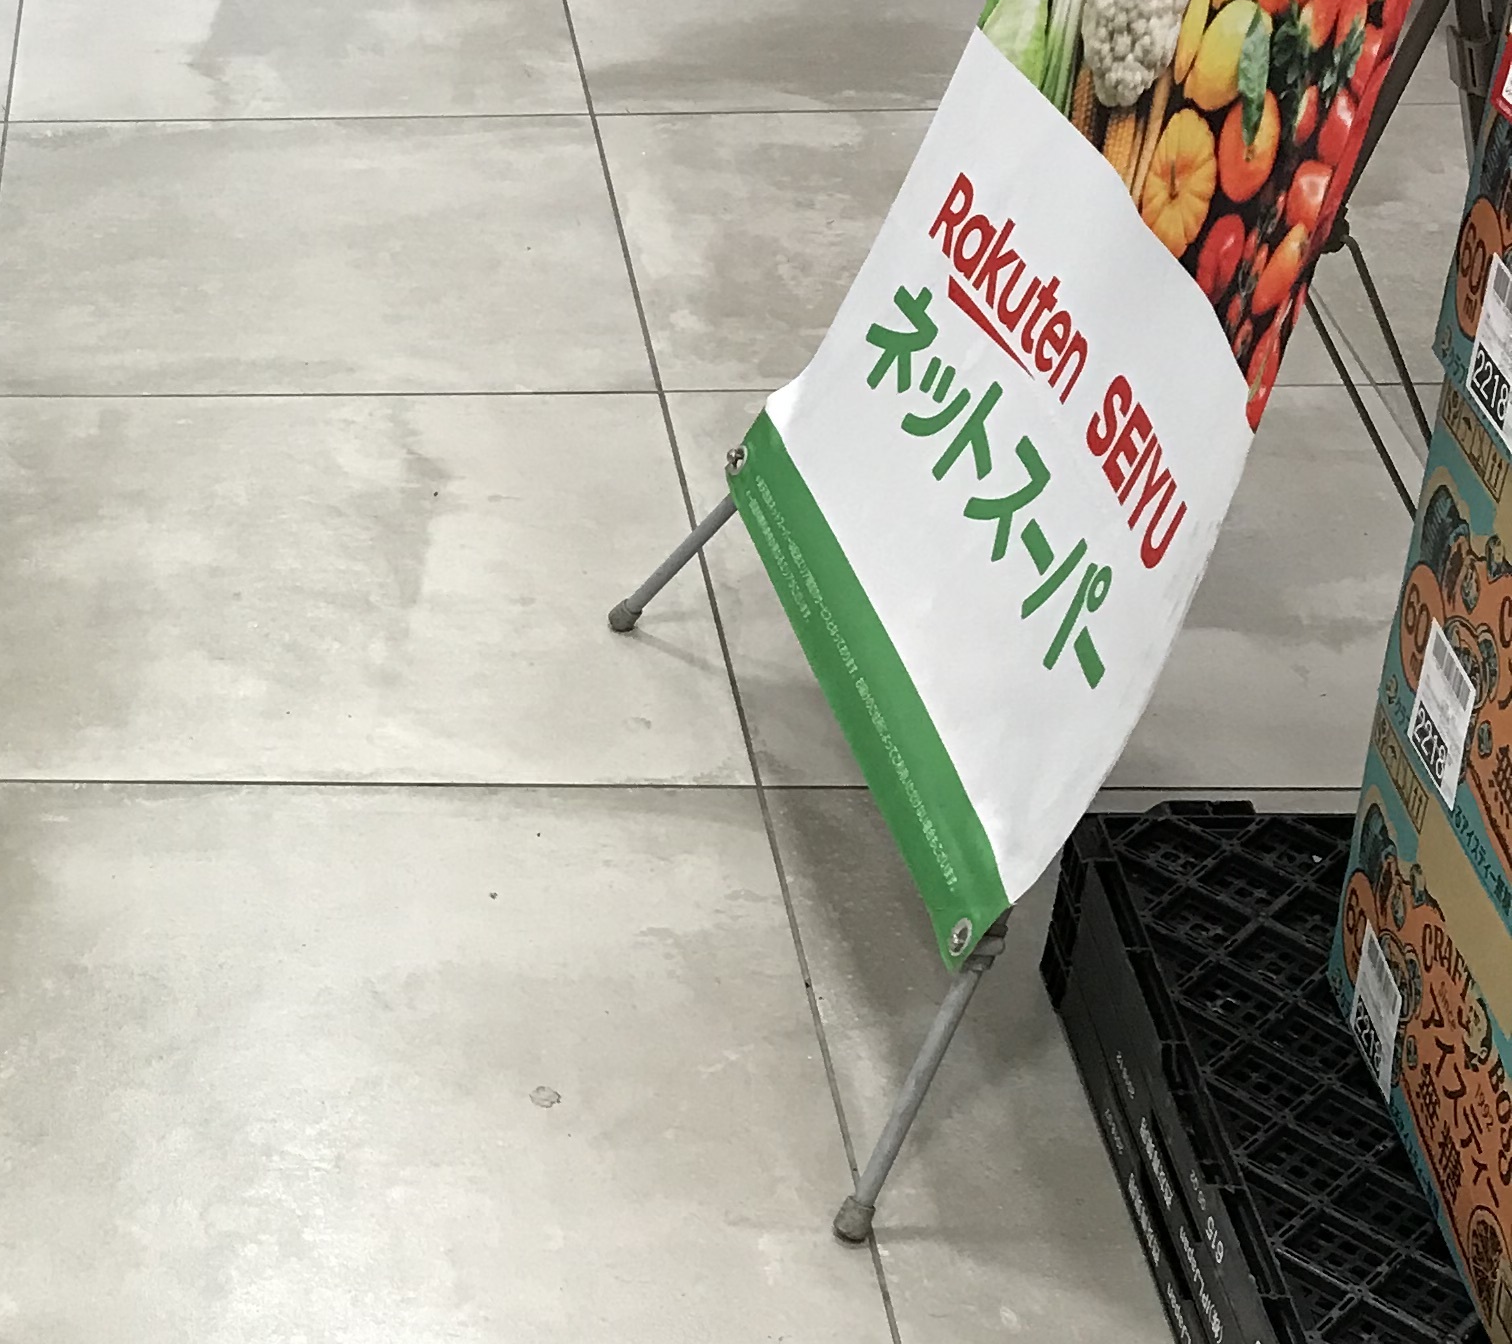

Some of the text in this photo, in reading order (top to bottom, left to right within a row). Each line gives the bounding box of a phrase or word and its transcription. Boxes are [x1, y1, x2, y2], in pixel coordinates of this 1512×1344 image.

[928, 171, 1189, 570] Rakuten SEIYU
[1471, 349, 1509, 422] 2218
[865, 284, 1113, 690] ネットスーパー
[1412, 707, 1447, 781] 2218
[1422, 923, 1476, 1002] CRAFT
[1205, 1215, 1225, 1264] 615
